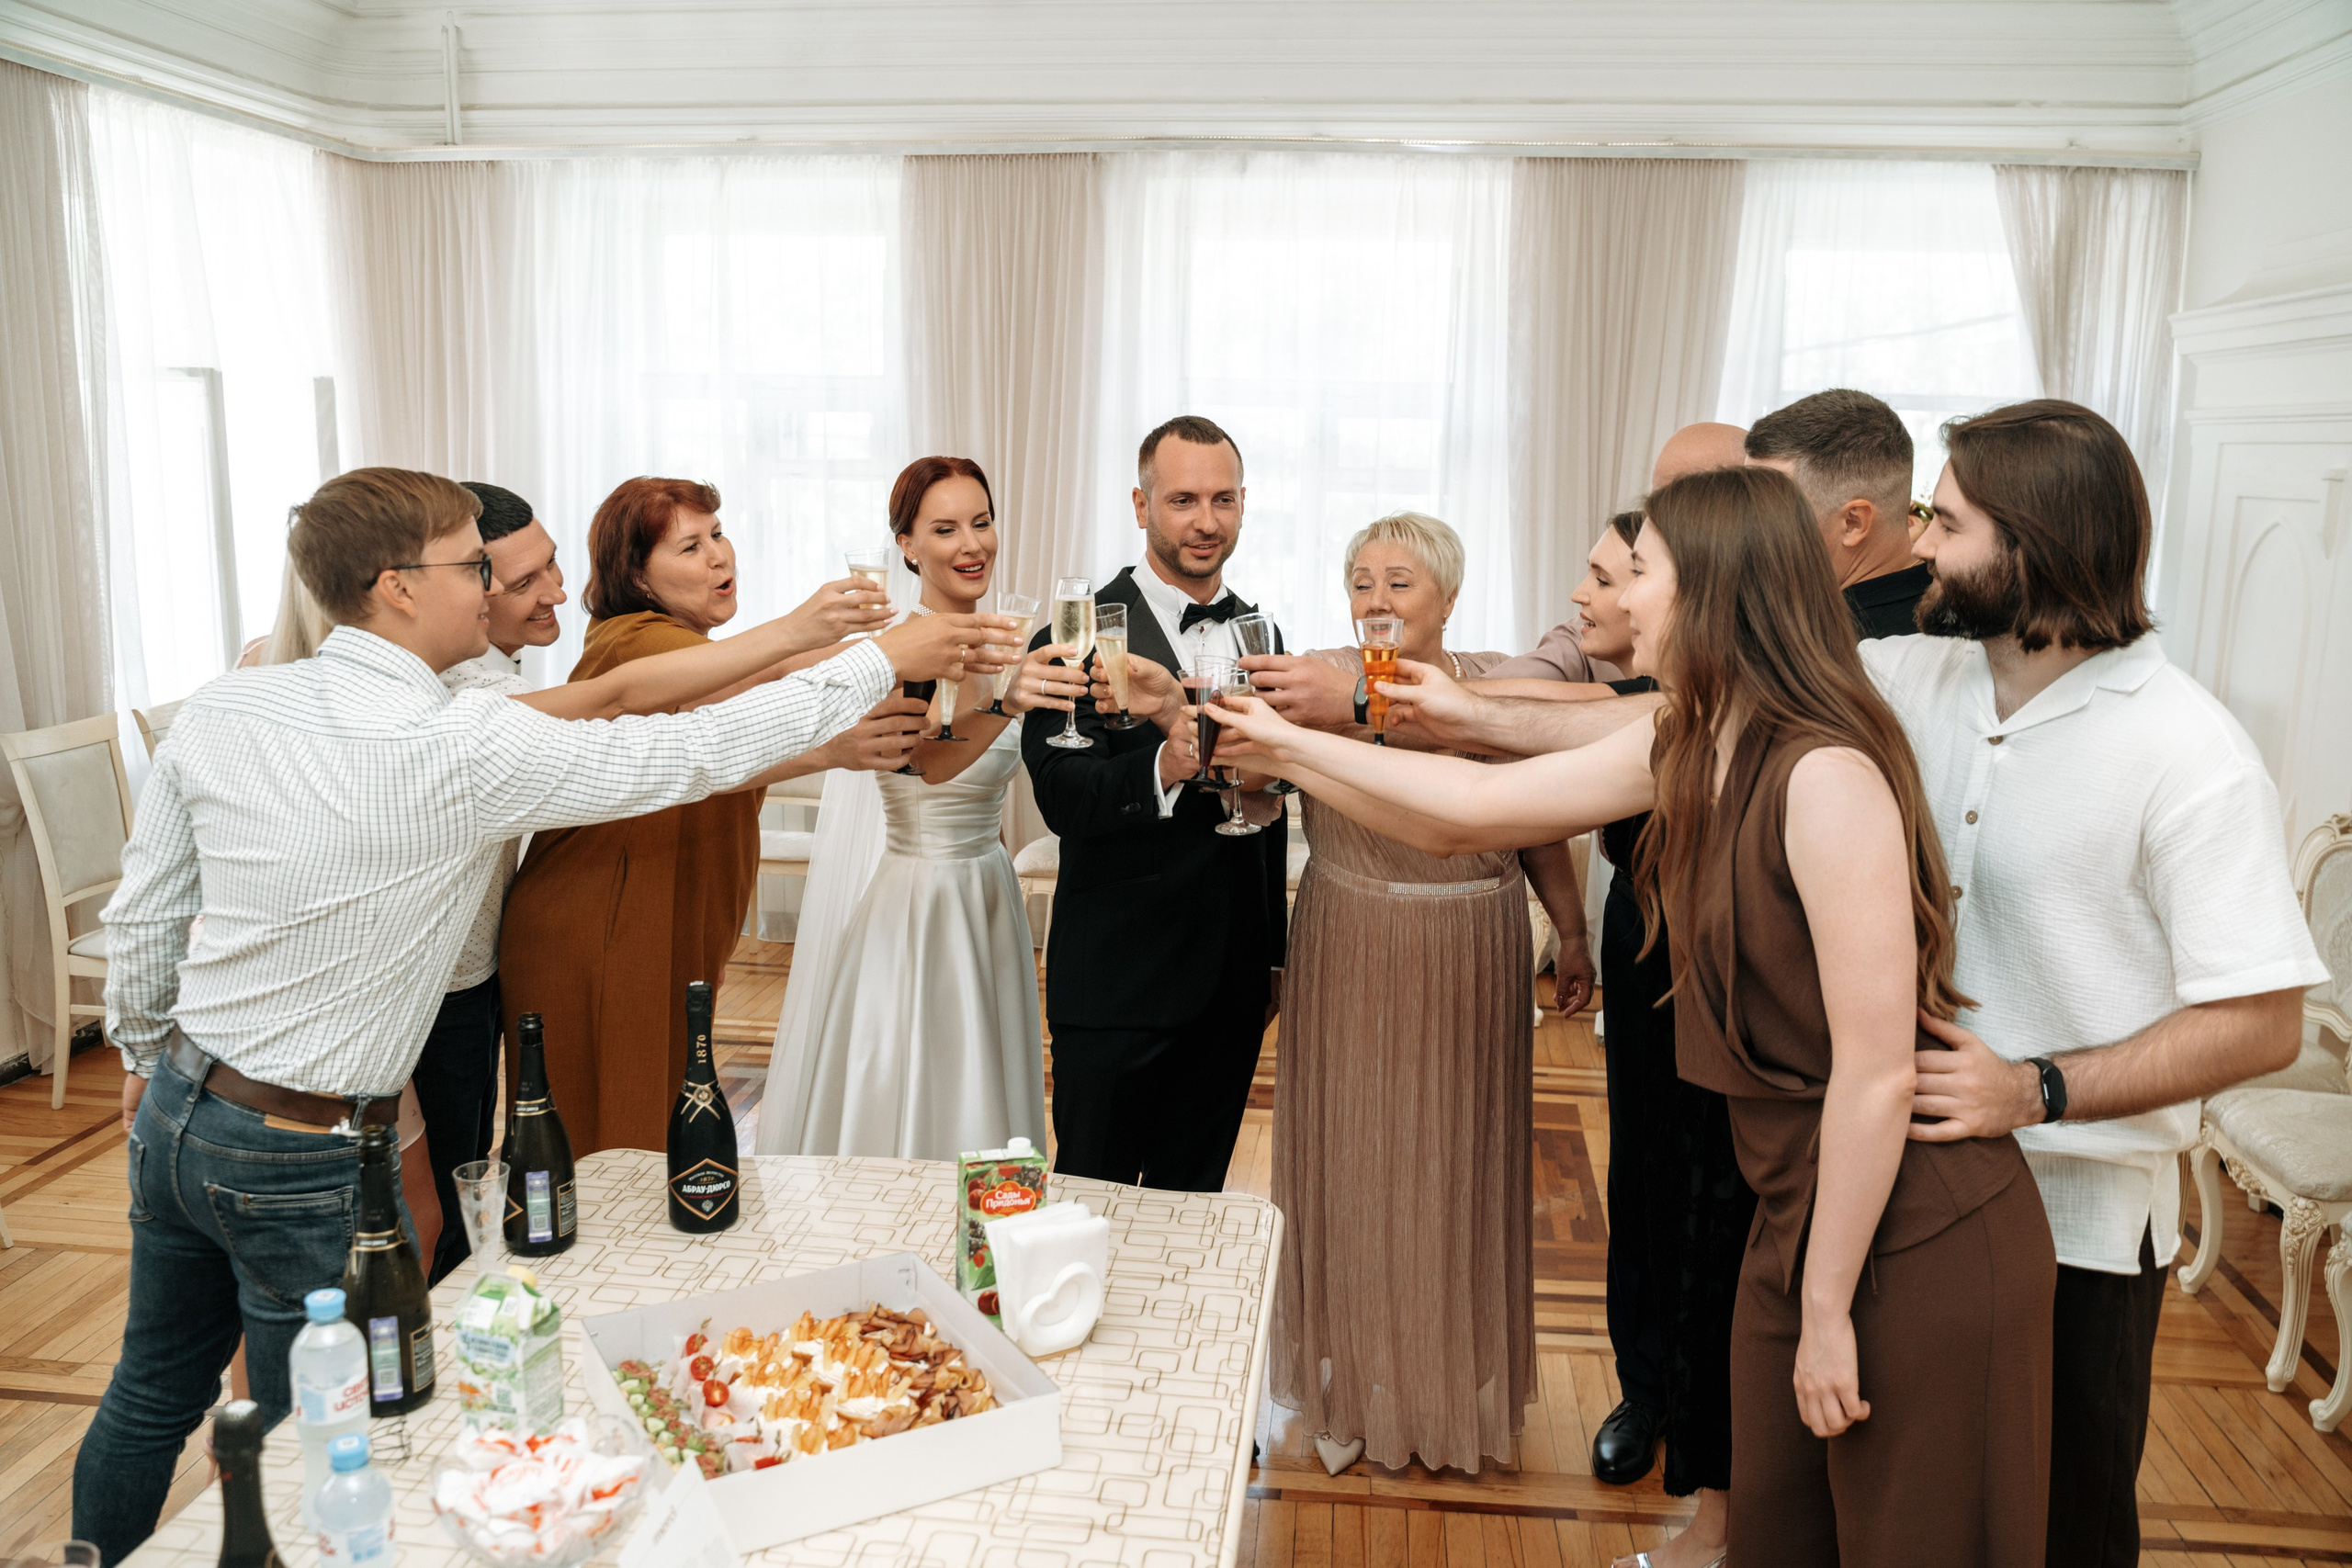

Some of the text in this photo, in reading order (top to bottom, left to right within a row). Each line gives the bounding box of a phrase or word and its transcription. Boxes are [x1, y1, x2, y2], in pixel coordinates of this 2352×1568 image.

[695, 1034, 707, 1064] 1870
[682, 1180, 731, 1194] АБРАУ-ДЮРСО
[995, 1190, 1021, 1200] Сады
[986, 1197, 1031, 1210] Придонья
